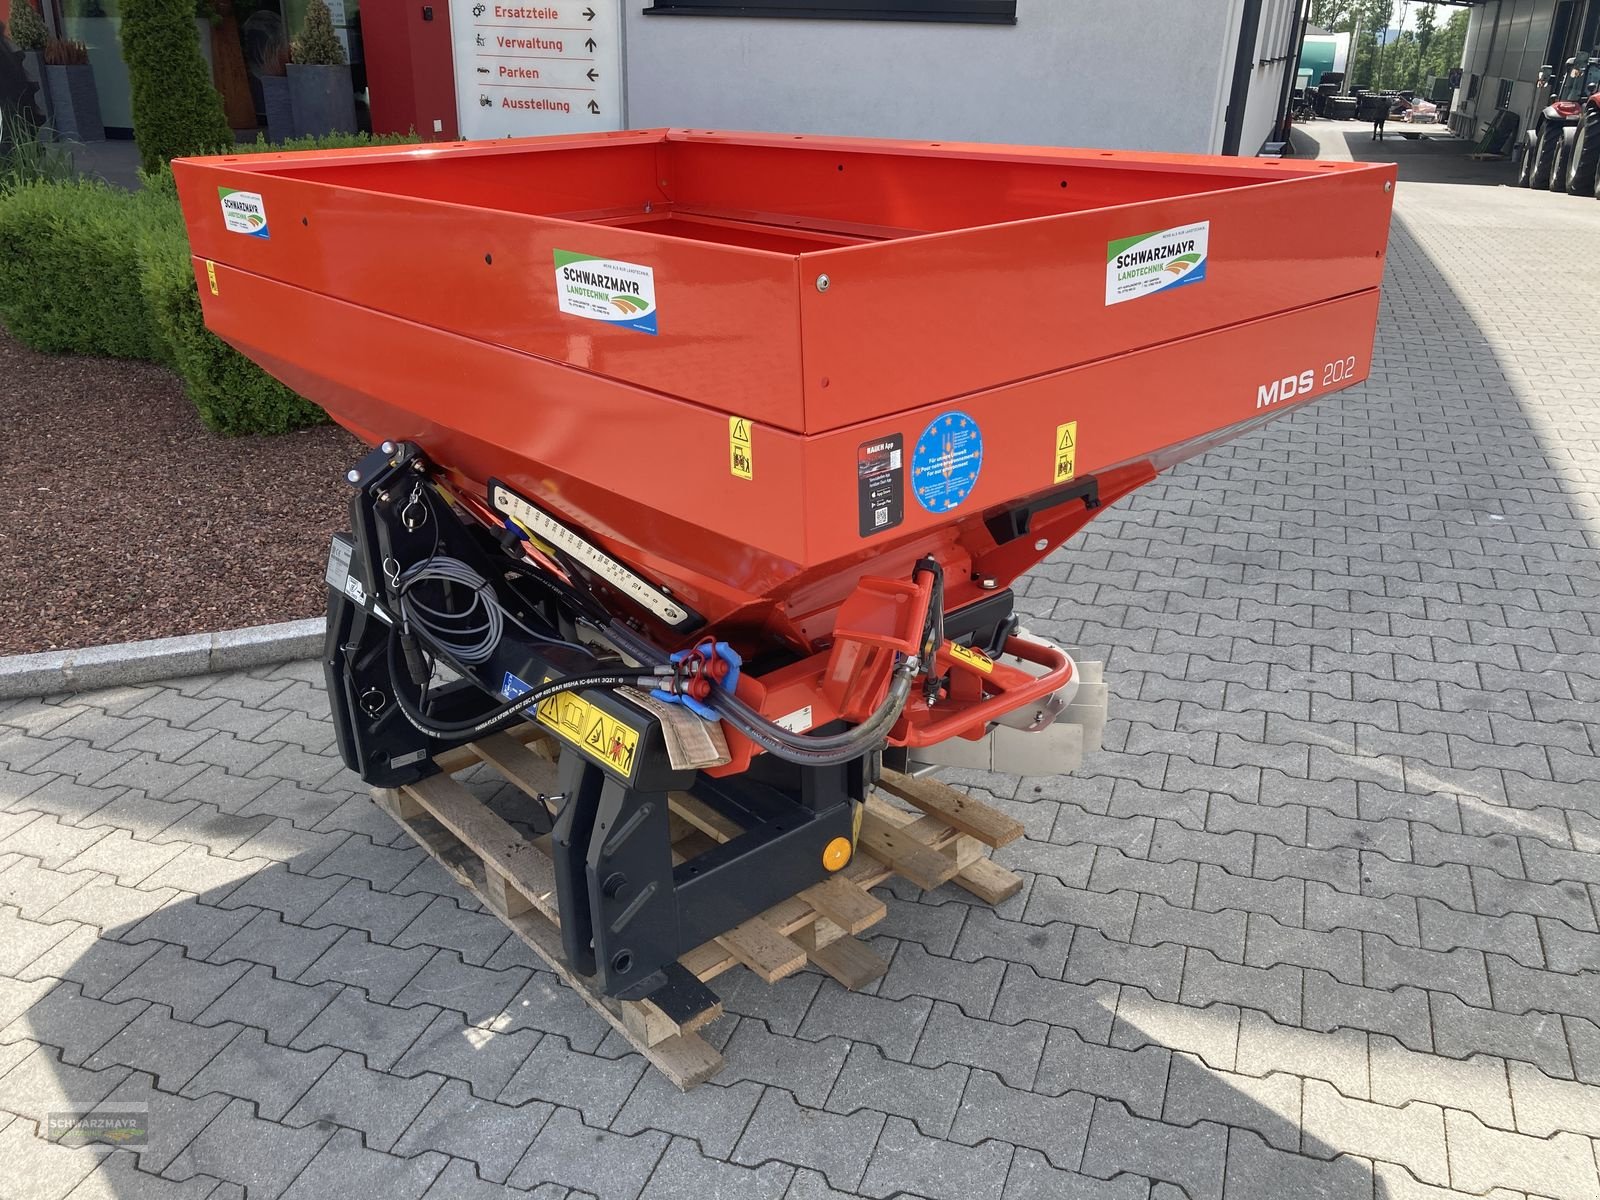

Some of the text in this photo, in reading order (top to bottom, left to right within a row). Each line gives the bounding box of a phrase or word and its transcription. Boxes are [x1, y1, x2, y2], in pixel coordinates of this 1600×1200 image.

[495, 6, 558, 20] Ersatzteile
[497, 36, 562, 52] Verwaltung
[499, 66, 539, 79] Parken
[502, 98, 570, 113] Ausstellung
[224, 199, 258, 213] SCHWARZMAYR
[1117, 240, 1194, 269] SCHWARZMAYR
[1118, 263, 1164, 281] LANDTECHNIK
[563, 267, 640, 295] SCHWARZMAYR
[566, 285, 610, 302] LANDTECHNIK
[1256, 356, 1356, 408] MDS 20.2
[552, 684, 562, 692] BAR
